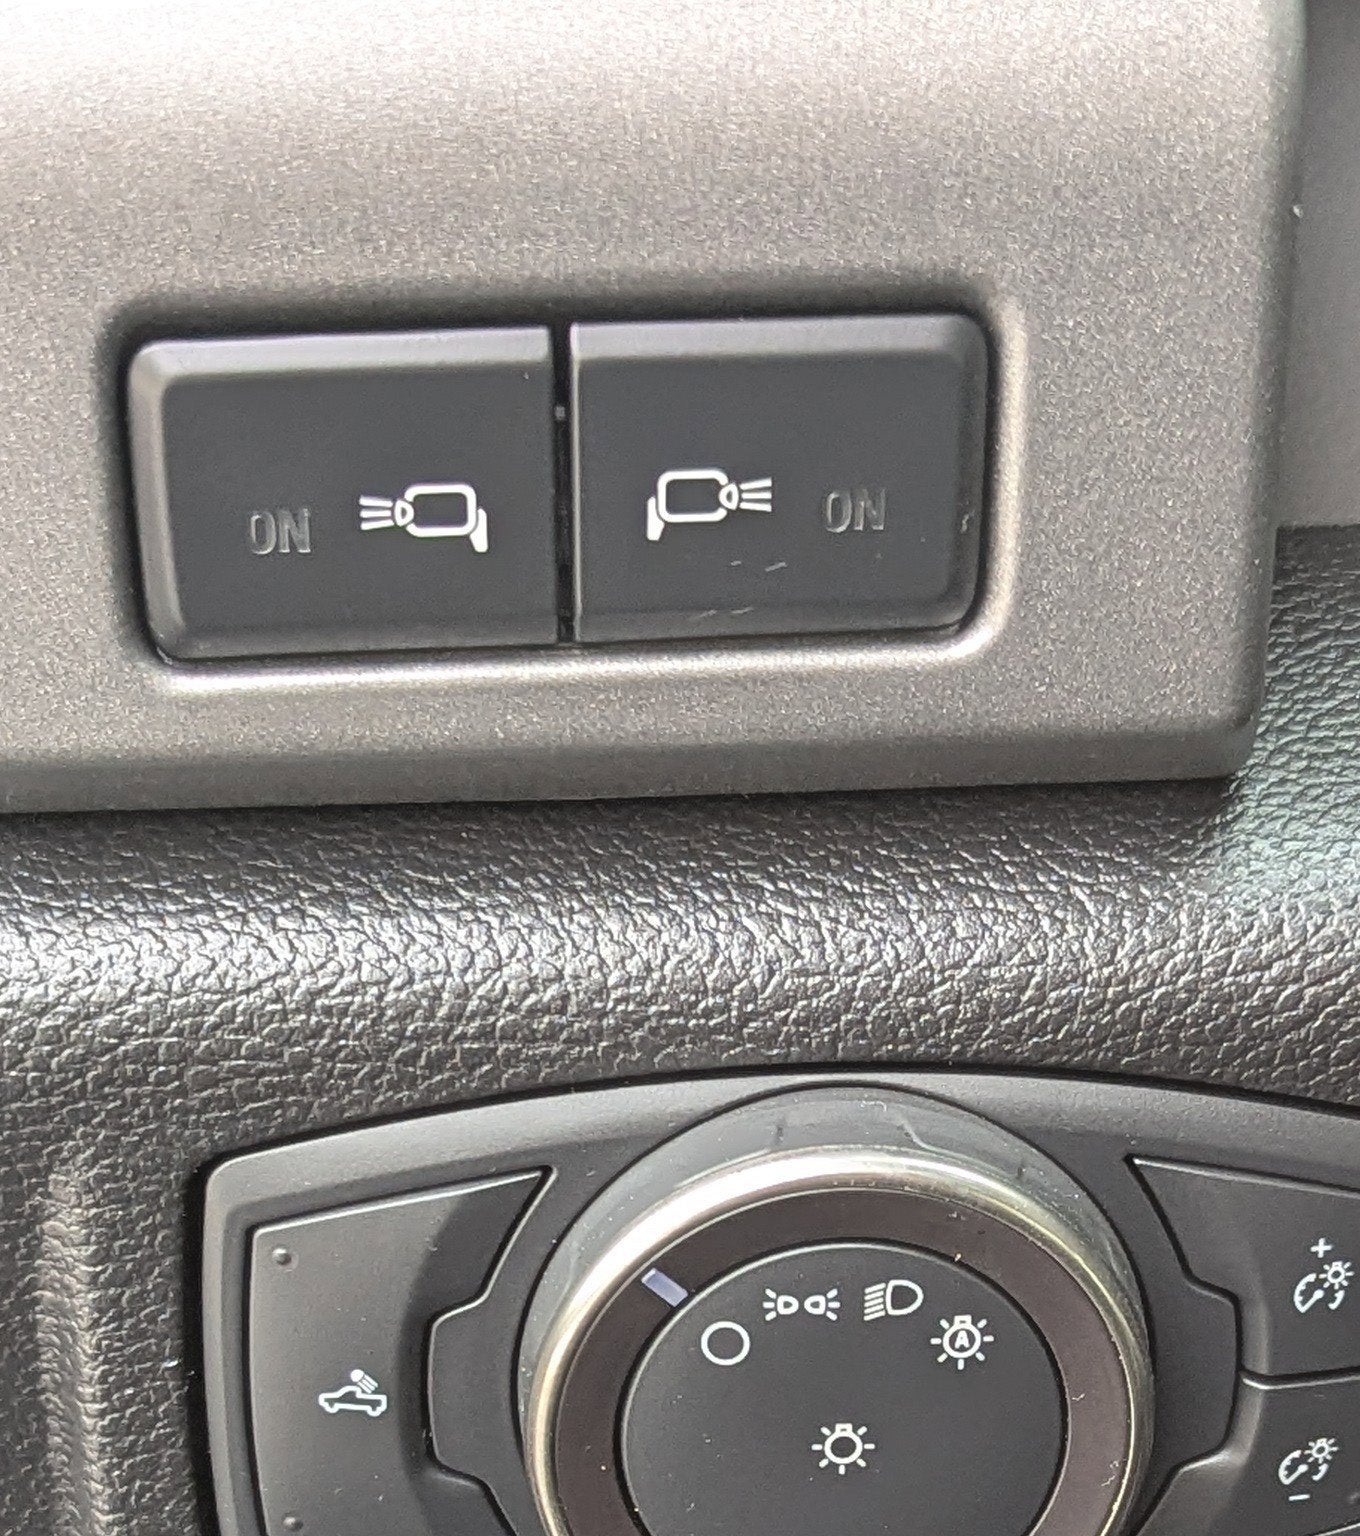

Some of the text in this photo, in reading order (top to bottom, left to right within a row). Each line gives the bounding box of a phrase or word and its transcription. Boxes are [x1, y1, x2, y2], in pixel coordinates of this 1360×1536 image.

[249, 507, 311, 555] ON
[824, 487, 887, 534] ON
[954, 1329, 970, 1349] A
